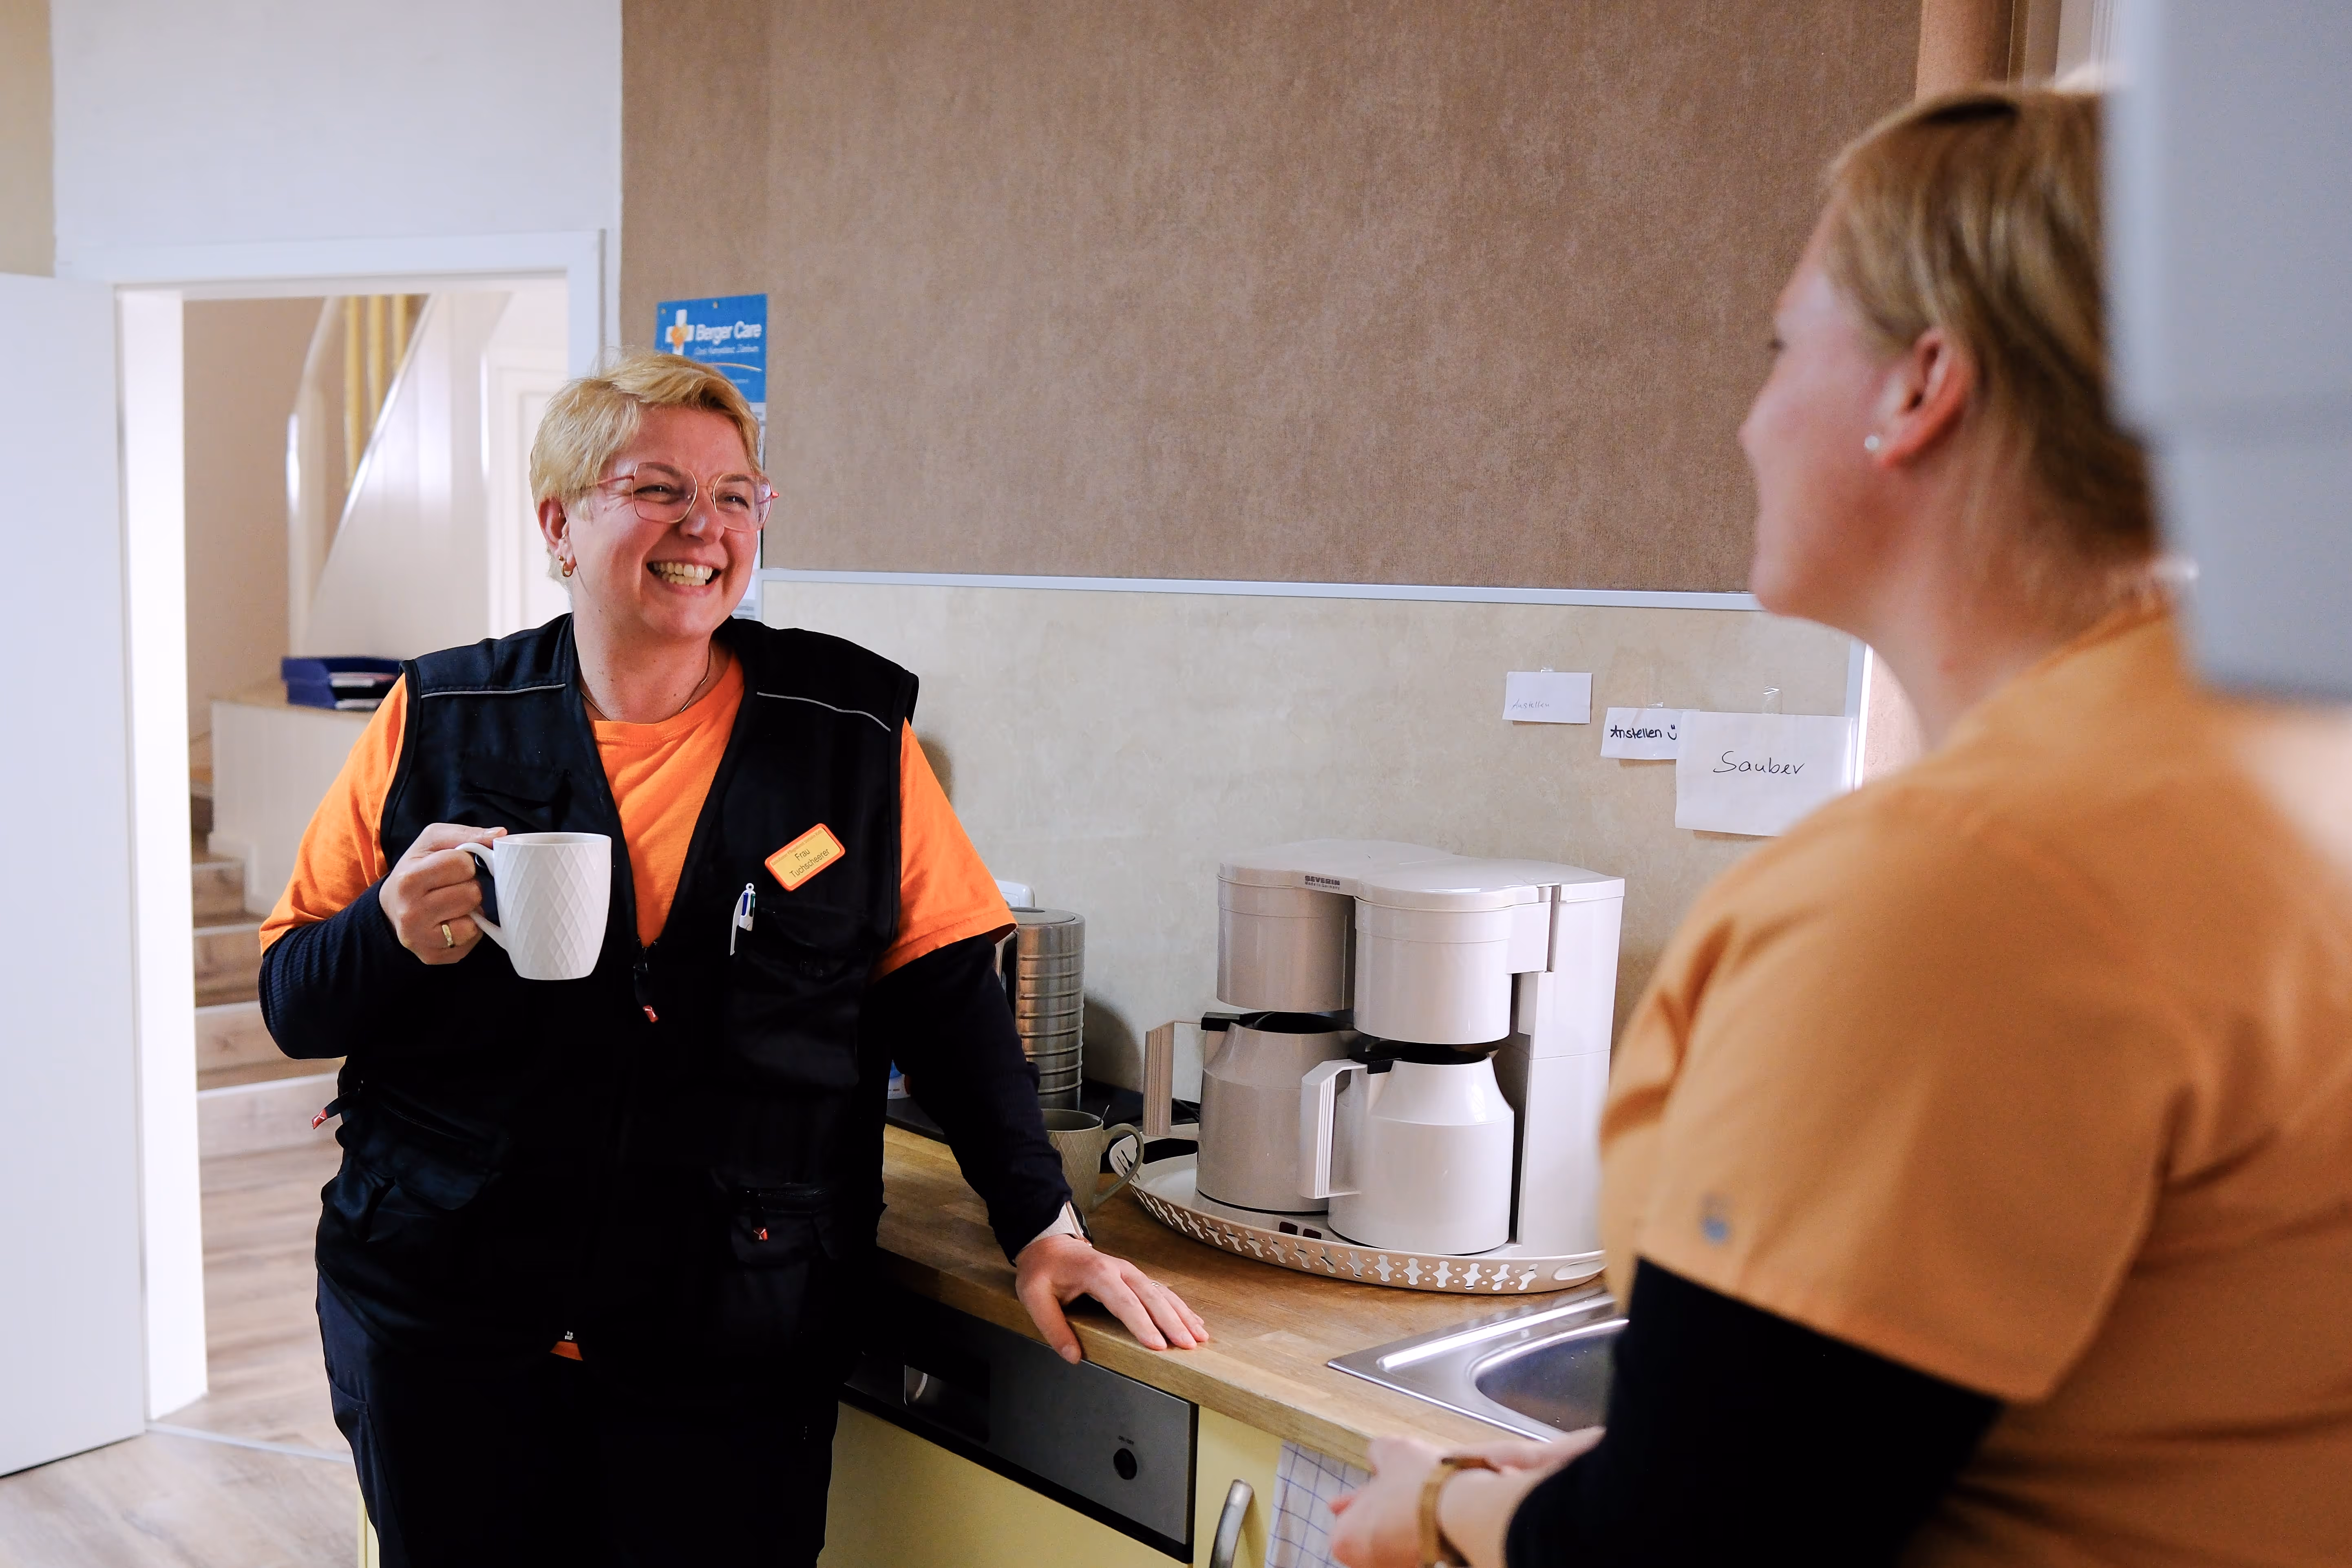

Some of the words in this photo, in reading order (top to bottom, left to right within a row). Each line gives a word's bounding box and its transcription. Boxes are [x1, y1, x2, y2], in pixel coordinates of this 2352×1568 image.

[734, 320, 762, 339] Care
[1510, 698, 1549, 711] Anstellen
[1610, 724, 1662, 739] Anstellen
[1713, 751, 1805, 774] Sauber
[794, 848, 811, 861] Frau
[789, 849, 830, 877] Tuchscheerer
[1305, 875, 1340, 886] SEVERIN
